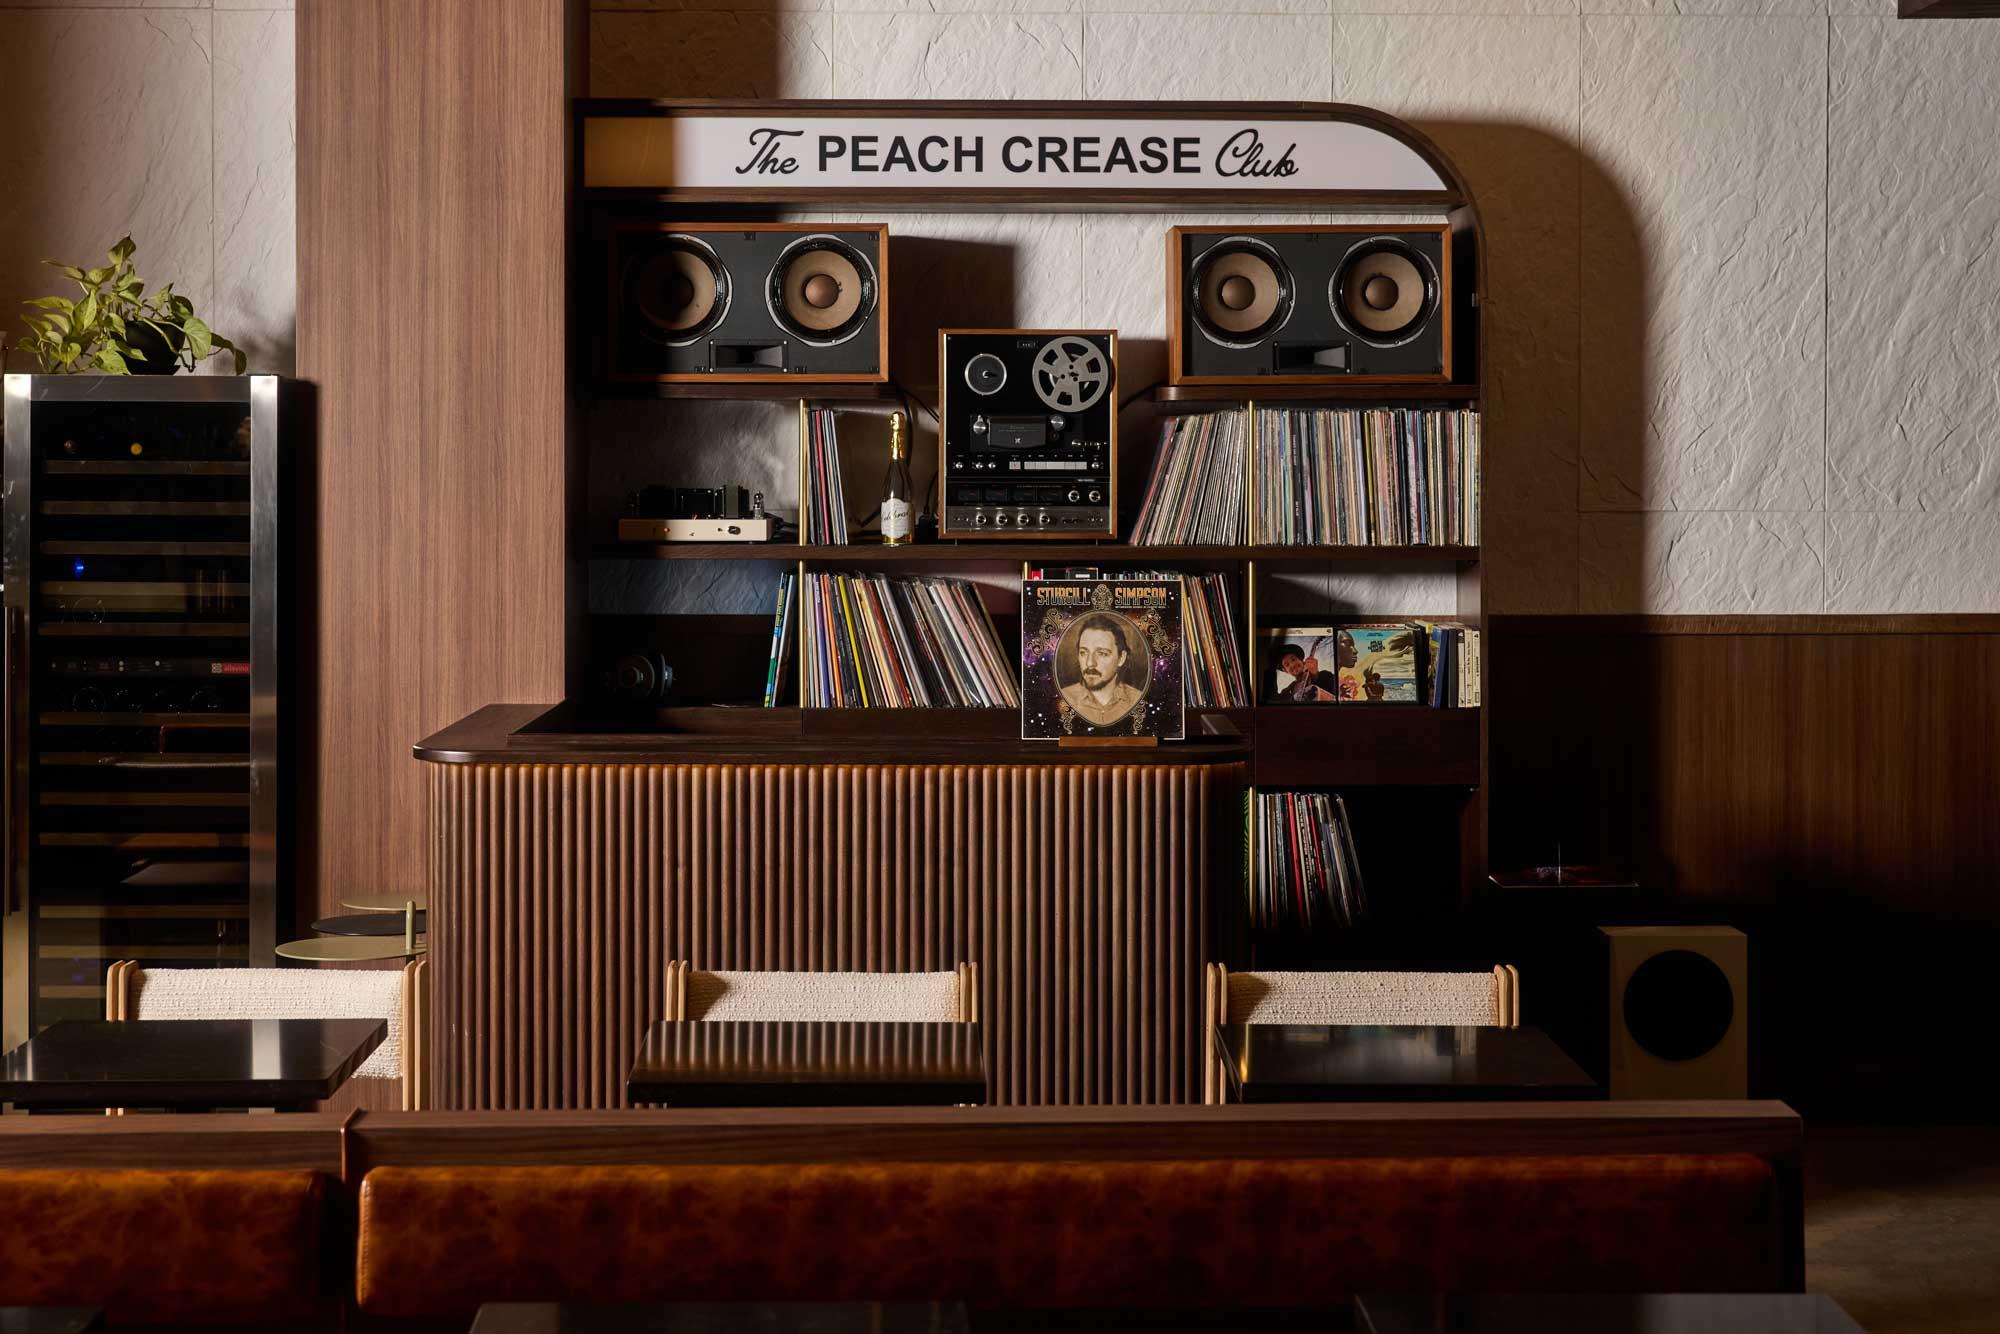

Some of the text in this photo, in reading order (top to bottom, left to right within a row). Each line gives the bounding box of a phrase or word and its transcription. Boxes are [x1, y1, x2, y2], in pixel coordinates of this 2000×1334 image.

[735, 128, 1300, 178] The PEACH CREASE Club
[1036, 587, 1167, 606] STURGILL SIMPSON
